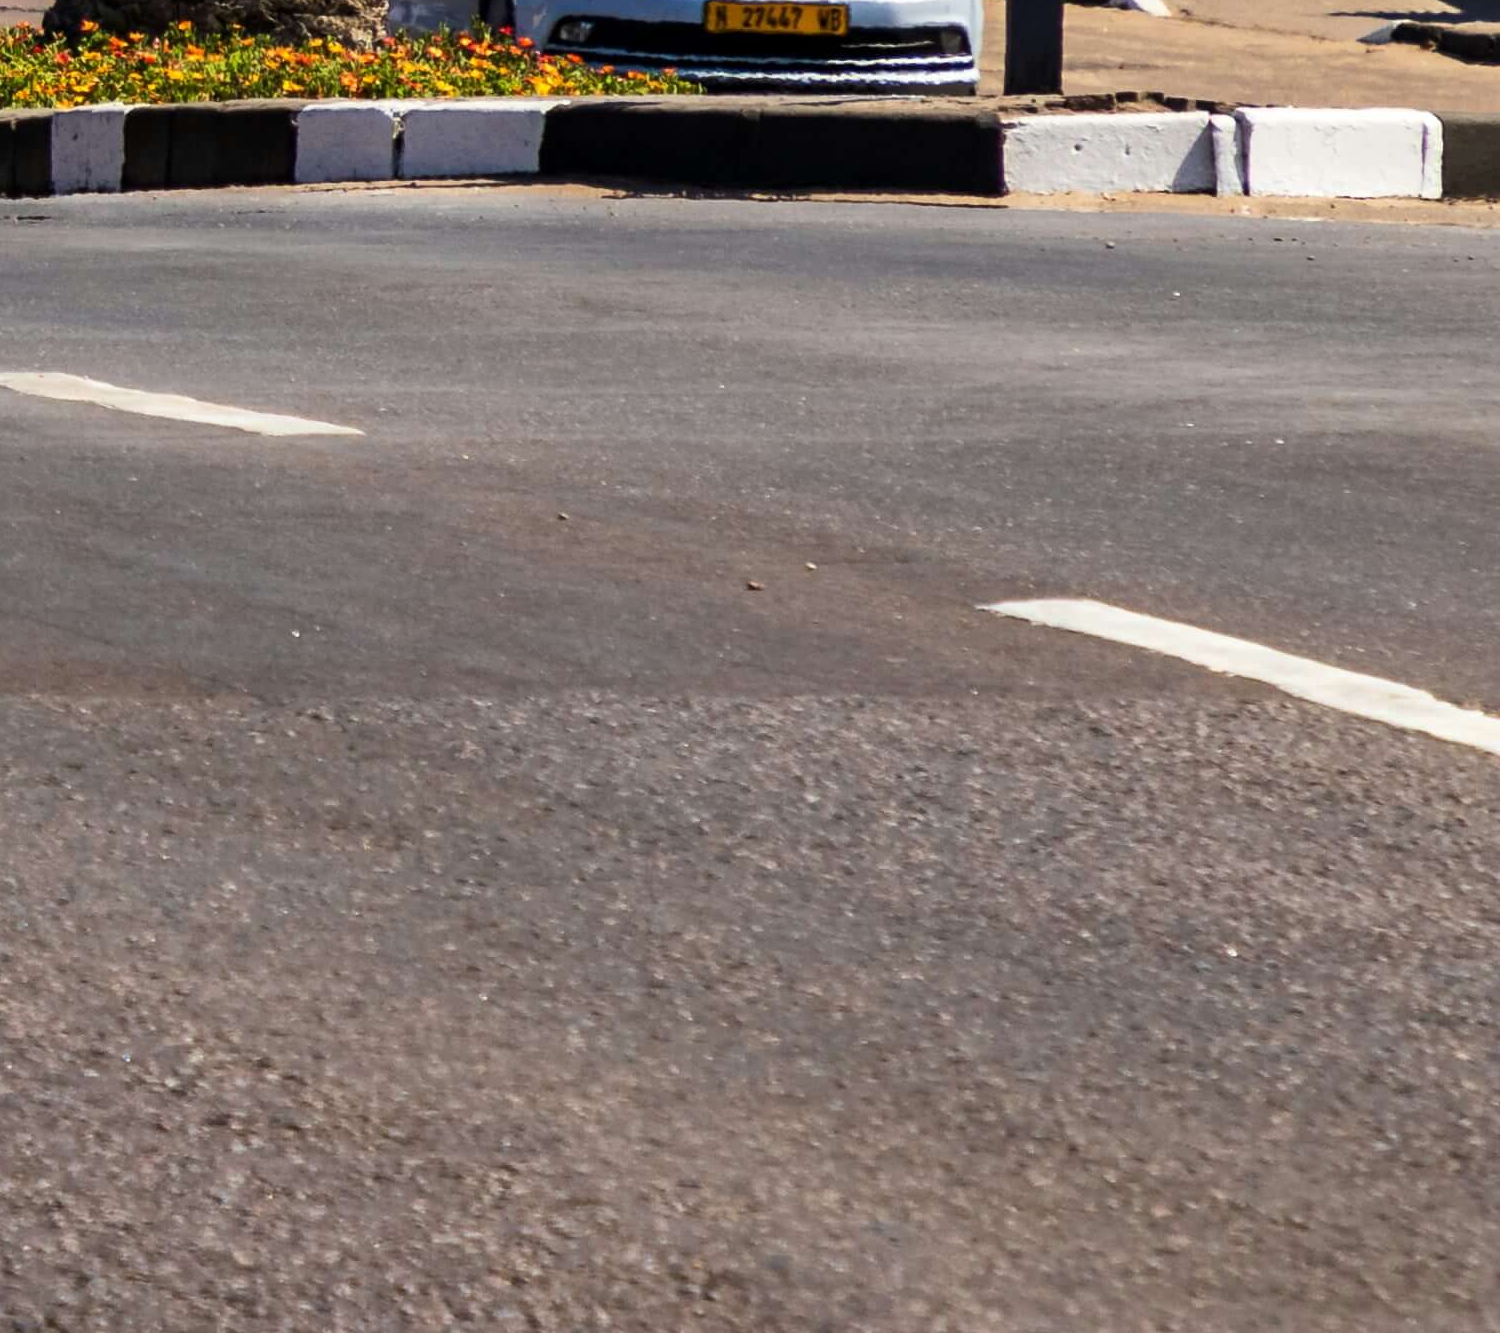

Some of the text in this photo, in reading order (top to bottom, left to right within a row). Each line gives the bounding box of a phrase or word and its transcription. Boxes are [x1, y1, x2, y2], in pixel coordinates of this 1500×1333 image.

[715, 5, 843, 31] N 27447 WB
